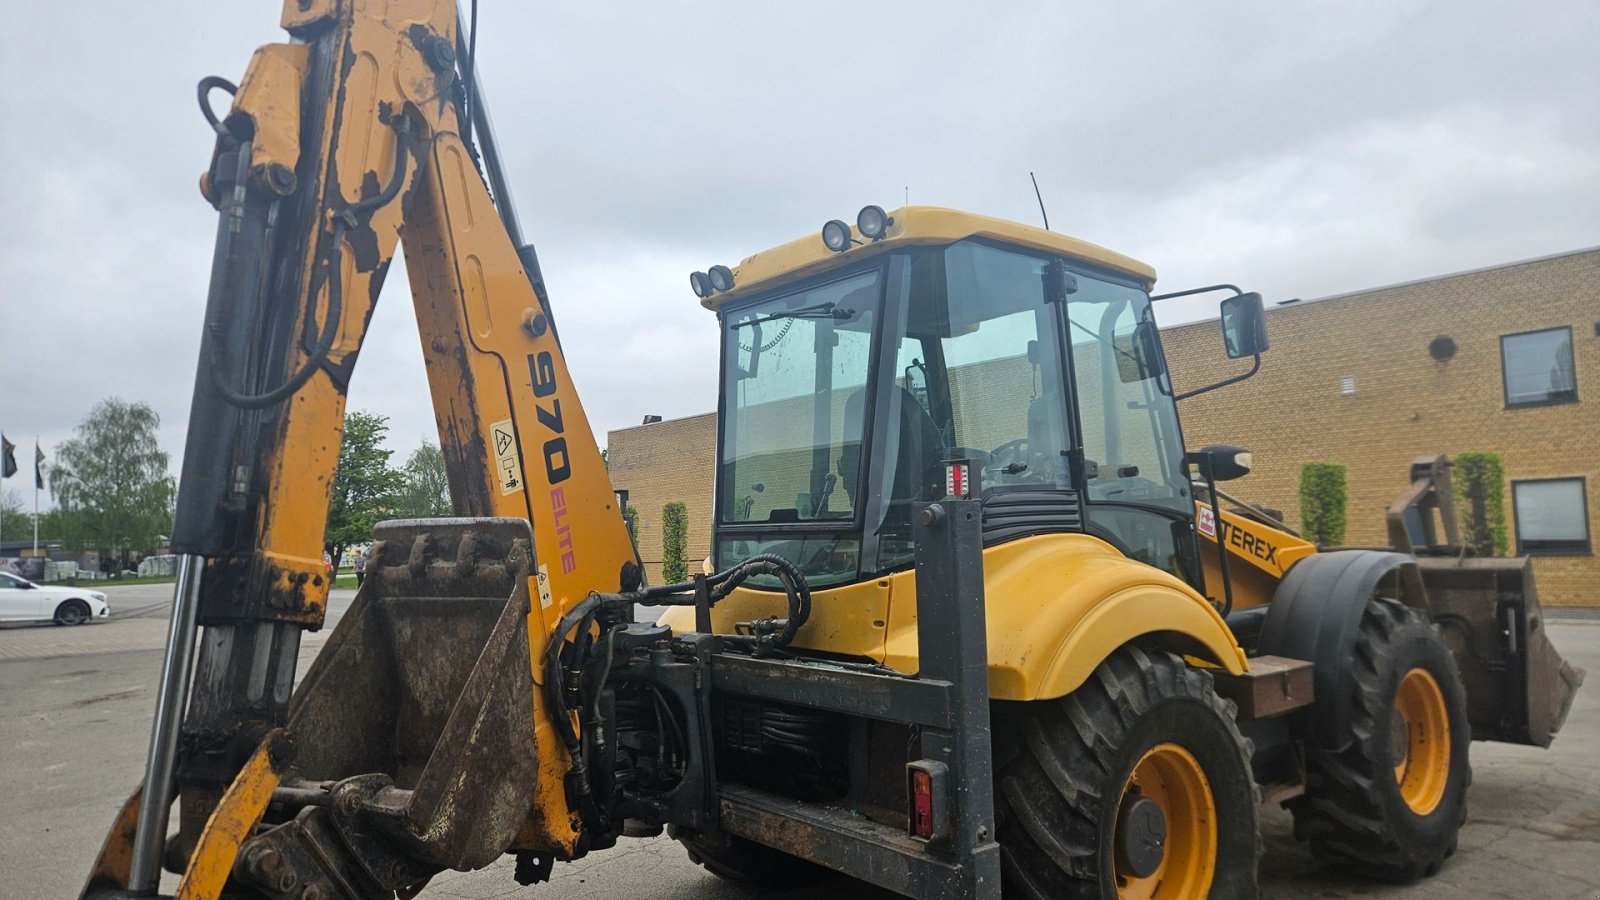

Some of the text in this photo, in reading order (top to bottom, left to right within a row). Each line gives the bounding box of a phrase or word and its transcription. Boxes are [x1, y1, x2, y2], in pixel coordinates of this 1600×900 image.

[528, 351, 576, 575] 970 ELITE
[1221, 520, 1277, 565] TEREX
